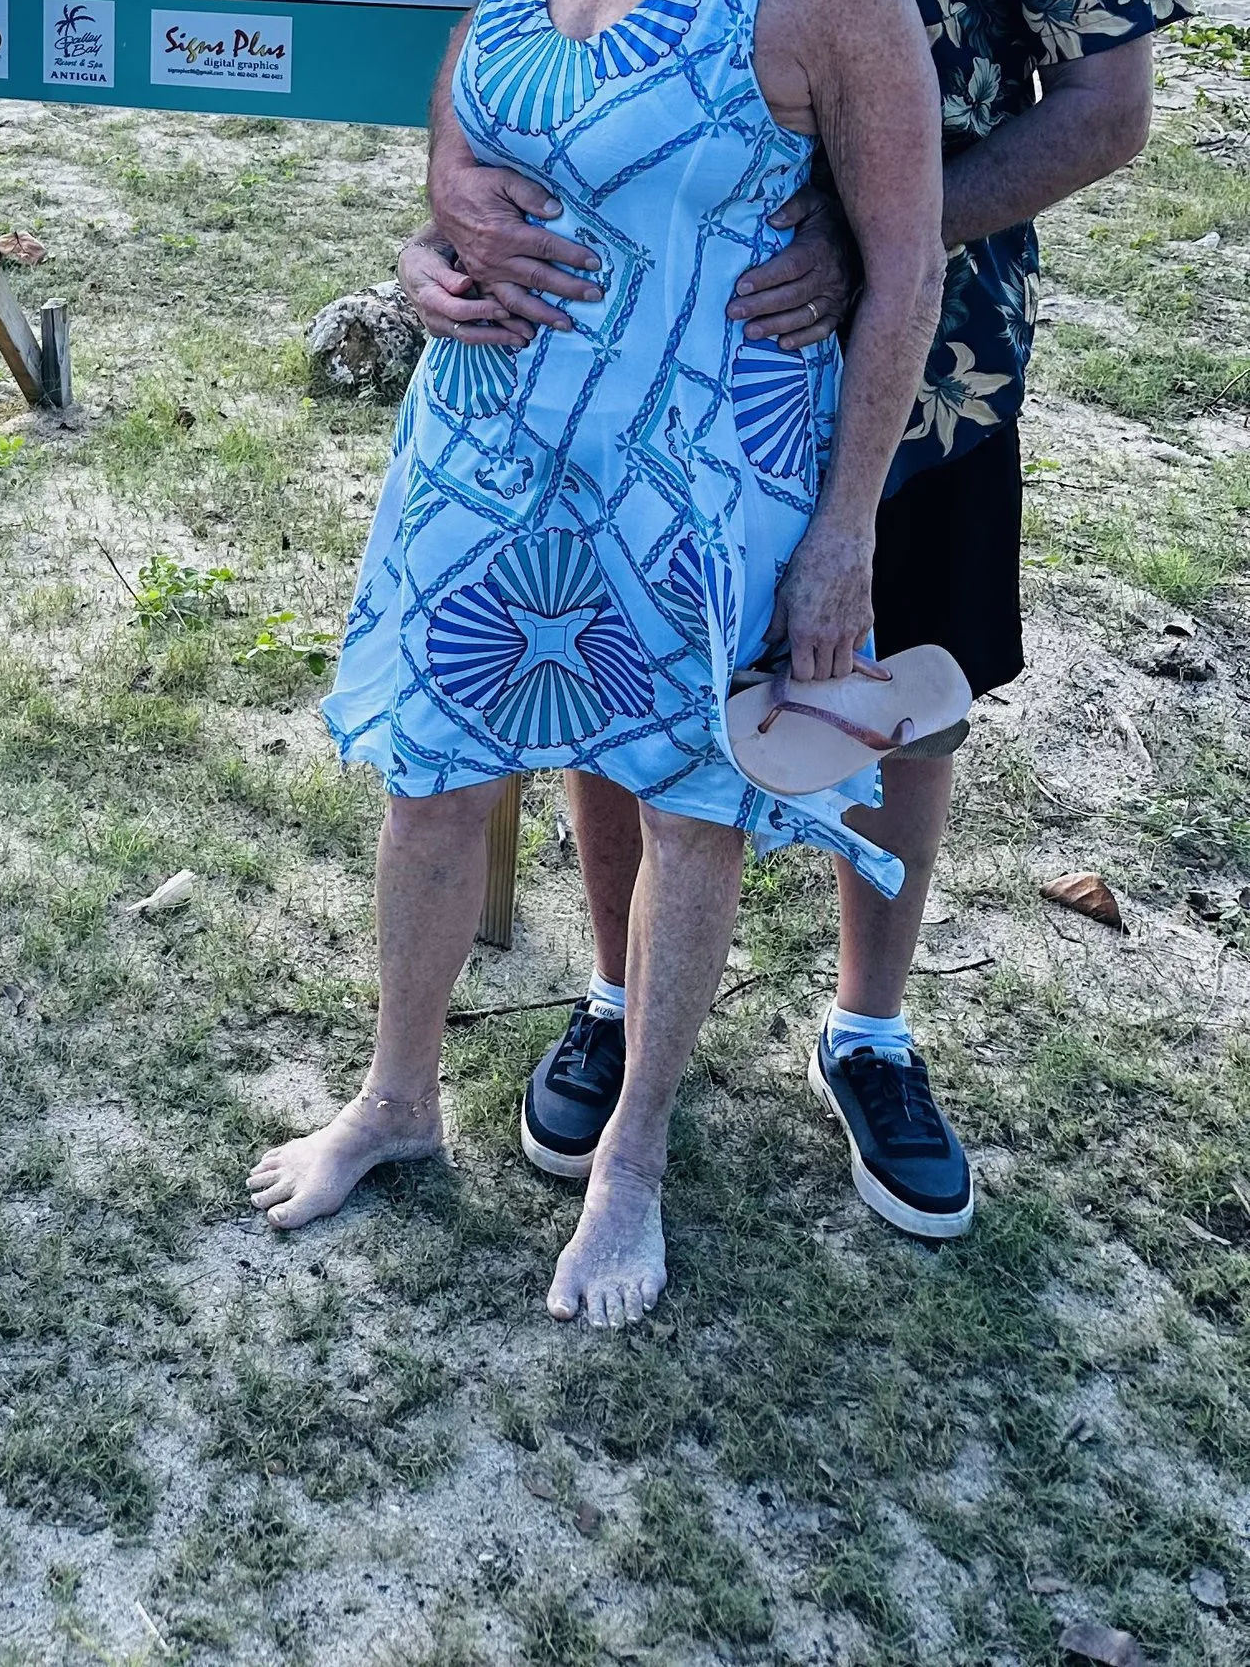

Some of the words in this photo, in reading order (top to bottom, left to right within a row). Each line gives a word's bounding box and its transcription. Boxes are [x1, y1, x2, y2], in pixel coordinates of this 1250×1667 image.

[71, 44, 103, 57] Bay
[165, 26, 225, 63] Signs
[233, 29, 285, 59] Plus
[204, 58, 235, 69] digital
[237, 60, 279, 71] graphics
[50, 71, 107, 82] ANTIGUA
